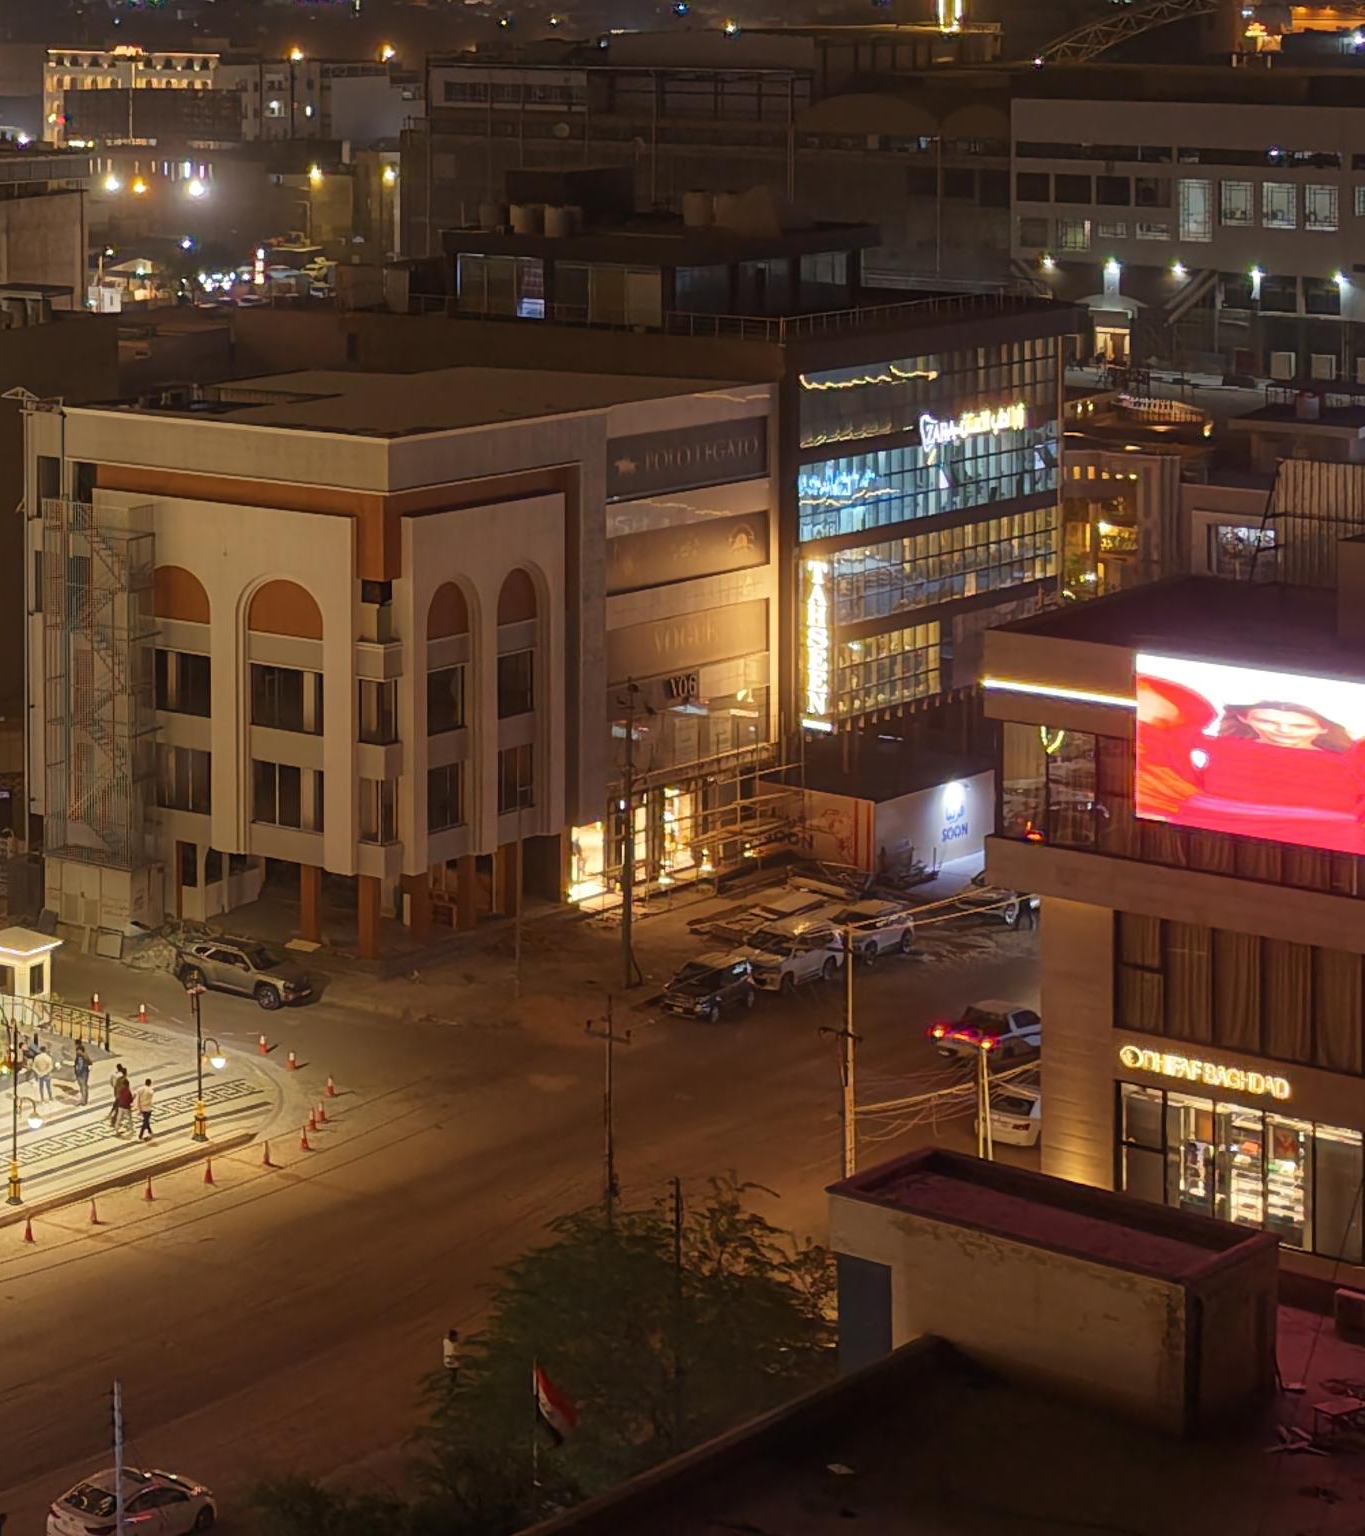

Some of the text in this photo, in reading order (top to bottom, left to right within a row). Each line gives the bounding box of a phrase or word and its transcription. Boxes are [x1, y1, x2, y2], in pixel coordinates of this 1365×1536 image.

[655, 617, 718, 656] VOGUE
[806, 558, 829, 715] TAHSEEN
[941, 822, 969, 843] SOON
[1142, 1049, 1291, 1100] DHIFAF BAGHDAD
